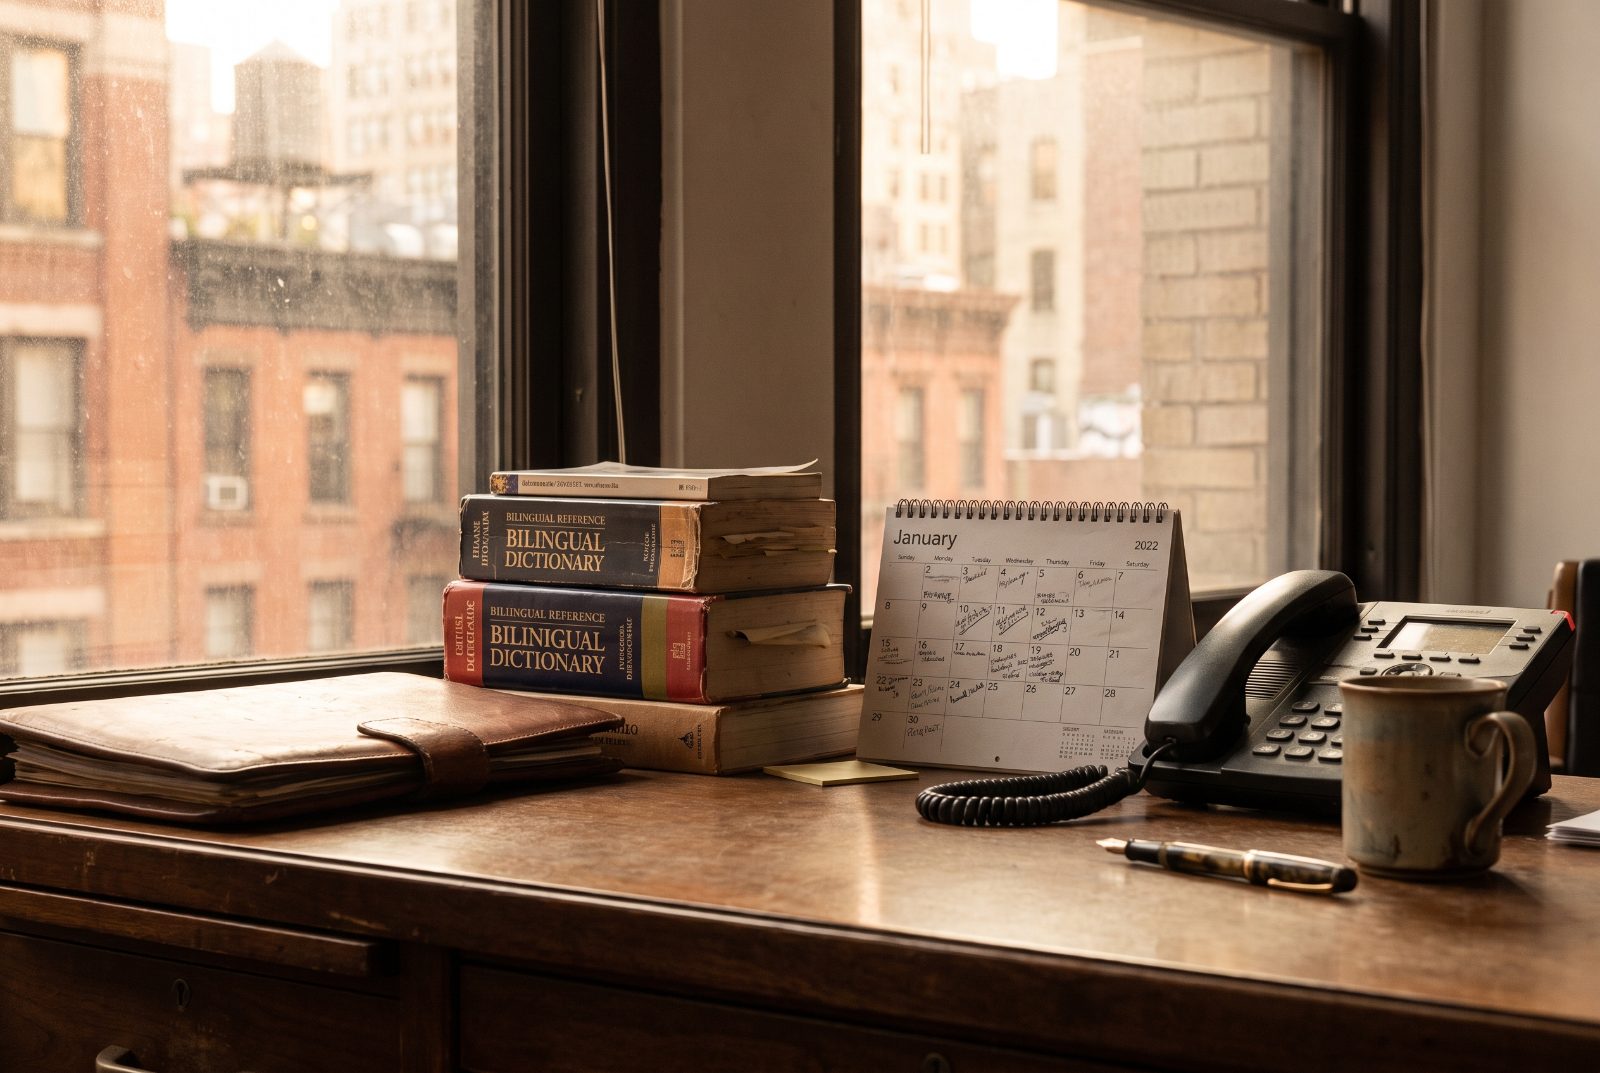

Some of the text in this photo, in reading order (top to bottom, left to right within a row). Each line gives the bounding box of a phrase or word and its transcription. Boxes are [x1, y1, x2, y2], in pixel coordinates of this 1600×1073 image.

[557, 514, 606, 525] REFERENCE
[506, 528, 606, 552] BILINGUAL
[893, 529, 958, 550] January
[1134, 540, 1159, 551] 2022
[504, 550, 605, 572] DICTIONARY
[897, 553, 916, 561] Sunday
[972, 556, 991, 564] Tuesday
[1005, 557, 1034, 565] Wednesday
[1046, 558, 1070, 566] Thursday
[1089, 559, 1106, 567] Friday
[1126, 560, 1150, 568] Saturday
[925, 565, 1124, 580] 2 3 4 5 6 7
[549, 609, 606, 623] REFERENCE
[884, 601, 891, 610] 8
[921, 603, 927, 611] 9
[959, 604, 969, 613] 10
[997, 606, 1006, 615] 11
[1035, 607, 1046, 616] 12
[1074, 609, 1085, 618] 13
[1114, 610, 1125, 620] 14
[881, 639, 891, 647] 15
[918, 640, 928, 649] 16
[955, 642, 965, 651] 17
[993, 644, 1003, 653] 18
[1031, 645, 1042, 655] 19
[1069, 647, 1081, 657] 20
[1109, 649, 1120, 658] 21
[490, 648, 605, 675] DICTIONARY
[876, 676, 887, 685] 22
[912, 678, 923, 687] 23
[949, 680, 960, 689] 24
[987, 682, 998, 691] 25
[1025, 684, 1037, 693] 26
[1064, 686, 1076, 695] 27
[1104, 688, 1116, 698] 28
[907, 715, 919, 724] 30
